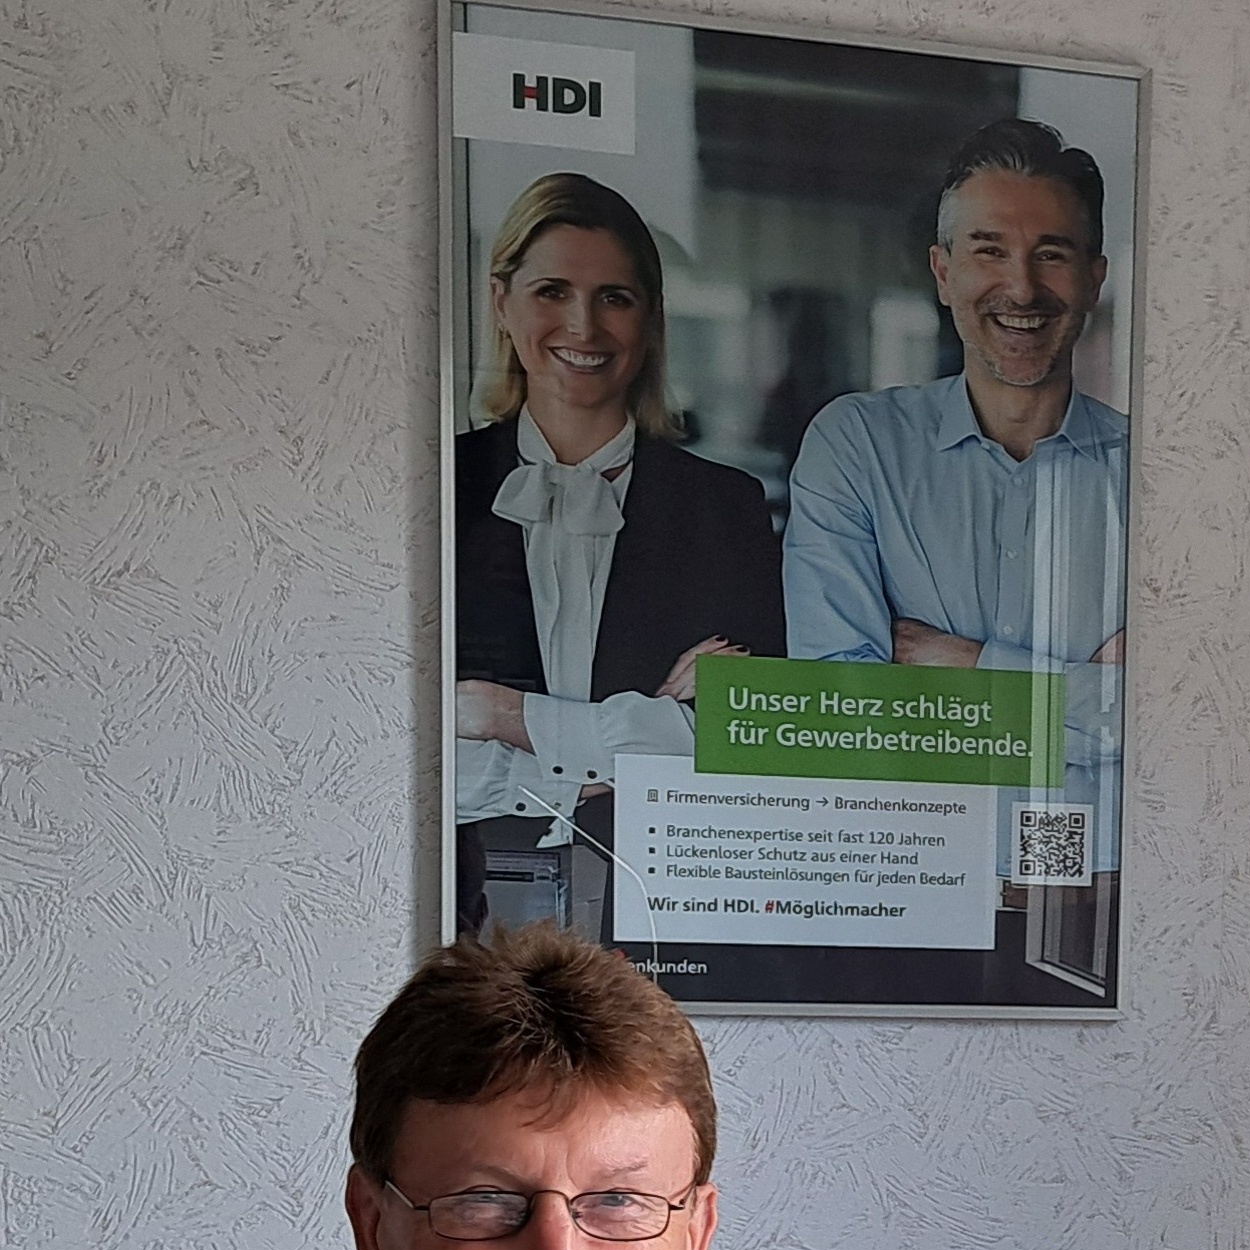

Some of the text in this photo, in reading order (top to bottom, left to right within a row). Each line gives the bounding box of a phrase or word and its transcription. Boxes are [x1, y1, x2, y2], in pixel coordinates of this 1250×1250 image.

[513, 73, 602, 118] HDI
[728, 686, 993, 724] Unser Herz schlägt
[728, 721, 1035, 759] für Gewerbetreibende.
[666, 789, 967, 817] Firmenversicherung Branchenkonzepte
[666, 824, 946, 848] Branchenexpertise seit fast 120 Jahren
[666, 844, 919, 866] Lückenloser Schutz aus einer Hand
[666, 864, 967, 889] Flexible Bausteinlösungen für jeden Bedarf
[647, 897, 907, 921] Wir sind HDI. #Möglichmacher
